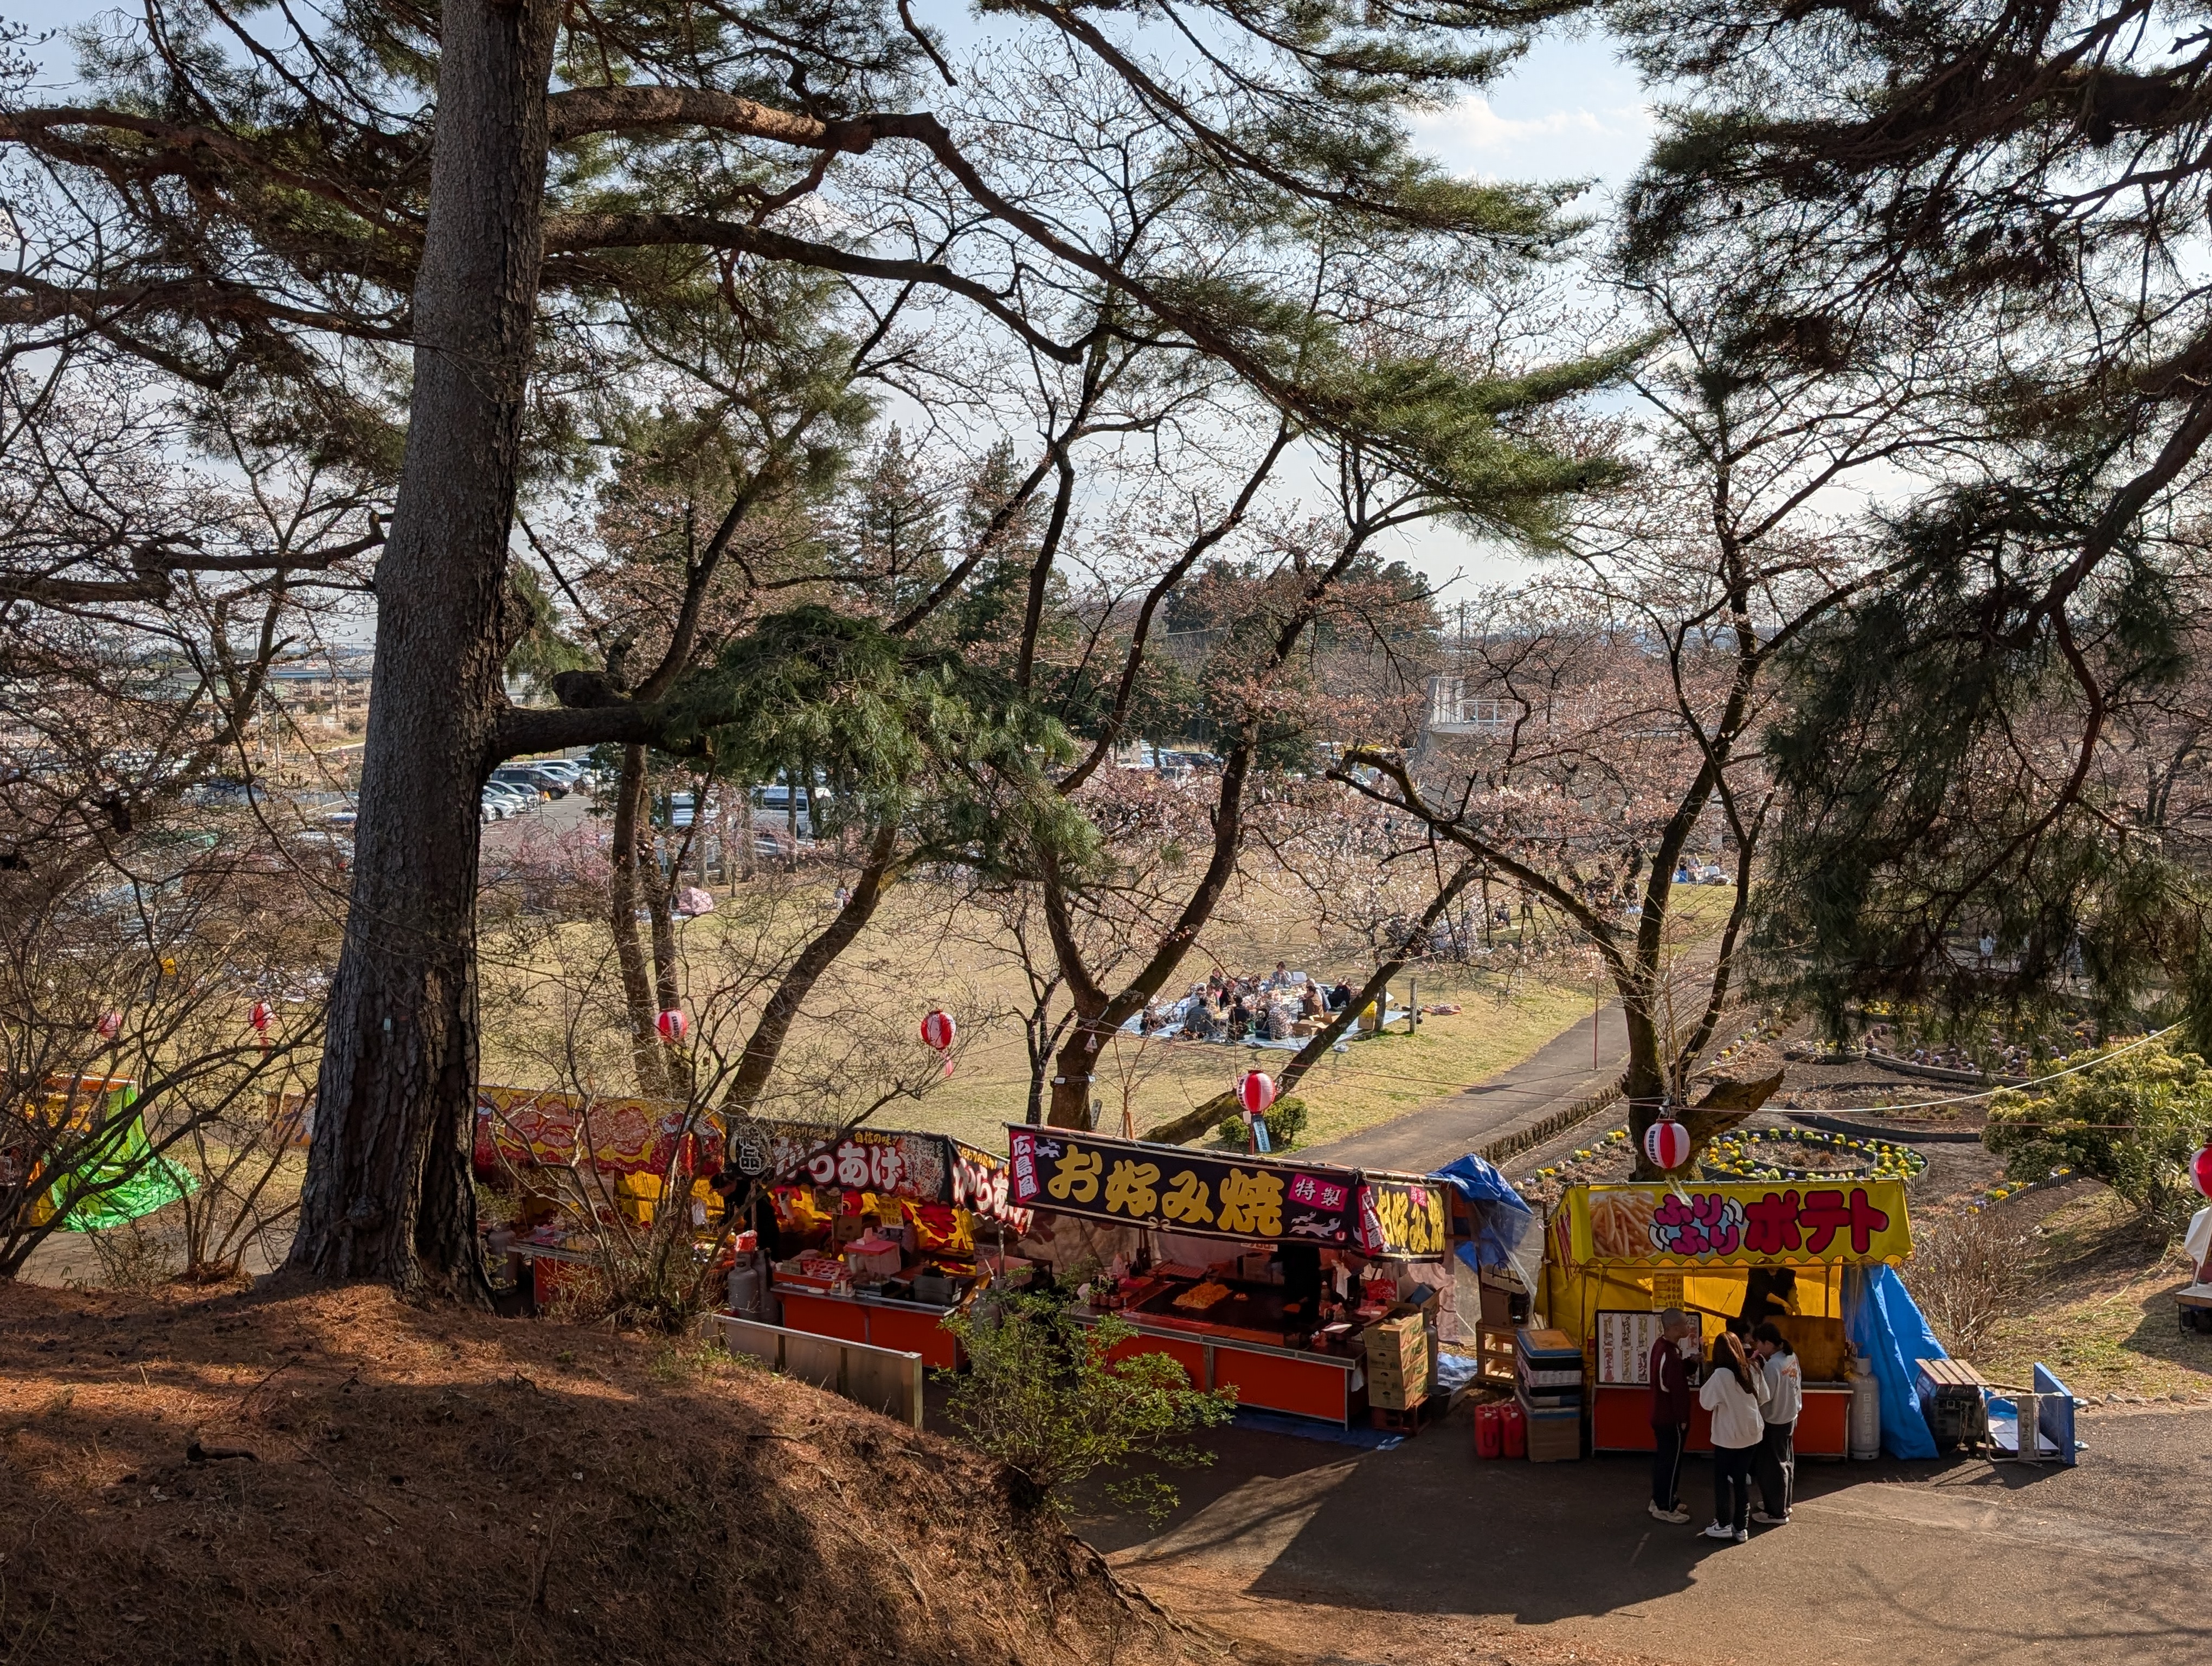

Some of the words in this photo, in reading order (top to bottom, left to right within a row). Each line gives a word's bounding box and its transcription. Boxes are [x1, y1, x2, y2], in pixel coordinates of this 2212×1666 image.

[773, 1137, 903, 1190] からあげ
[1013, 1135, 1037, 1199] 広島風
[1048, 1144, 1285, 1236] お好み焼
[1295, 1174, 1342, 1208] 特製
[1375, 1186, 1446, 1254] お好み焼
[1671, 1223, 1740, 1256] ふり
[1744, 1188, 1890, 1255] ポテト
